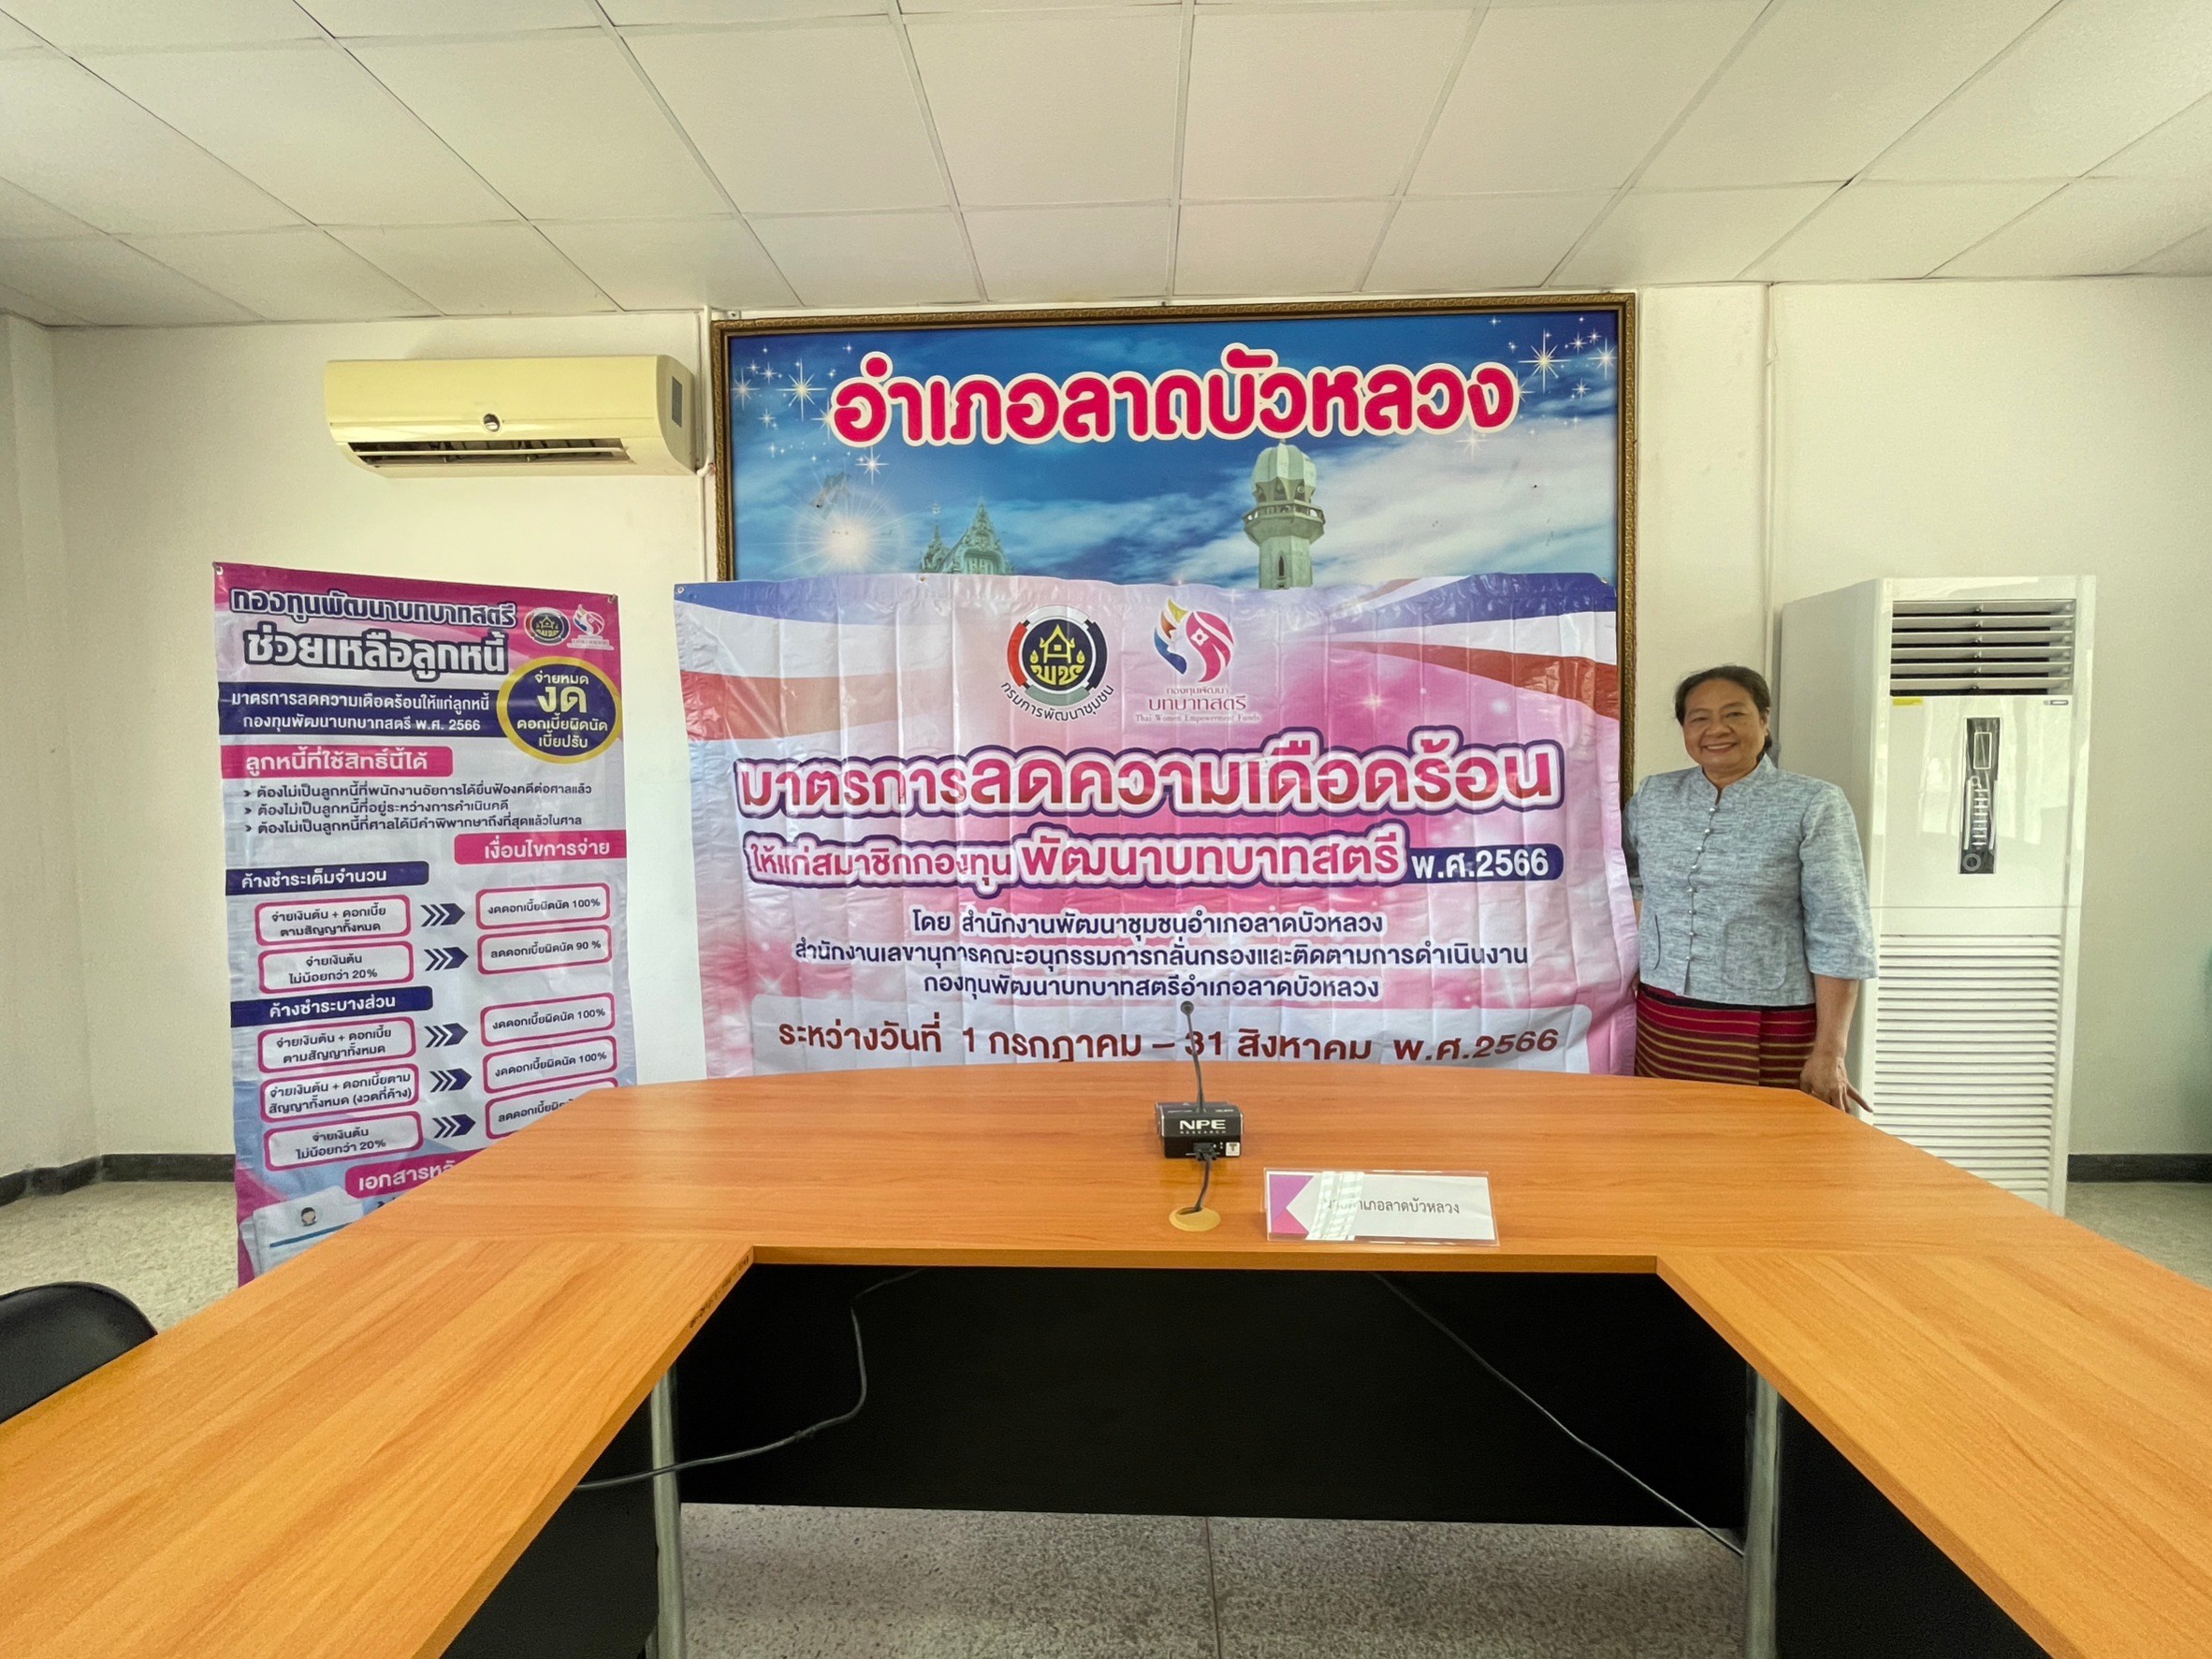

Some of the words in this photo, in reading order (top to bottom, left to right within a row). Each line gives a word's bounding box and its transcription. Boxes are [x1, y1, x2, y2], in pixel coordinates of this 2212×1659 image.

[832, 344, 1518, 444] อำเภอลาดบัวหลวง
[231, 589, 517, 628] กองทุนพัฒนาบทบาทสตรี
[245, 623, 507, 680] ช่วยเหลือลูกหนี้
[535, 670, 589, 684] จ่ายหมด
[232, 692, 489, 715] มาตรการลดความเดือดร้อนให้แก่ลูกหนี้
[537, 686, 588, 713] งด
[1000, 681, 1114, 721] กรมการพัฒนาชุมชน
[1148, 694, 1247, 711] บทบาทสตรี
[243, 714, 411, 732] กองทุนพัฒนาบทบาทสตรี
[416, 718, 444, 730] พ.ศ.
[448, 719, 481, 731] 2566
[517, 713, 608, 731] ดอกเบี้ยผิดนัด
[539, 731, 589, 749] เบี้ยปรับ
[246, 746, 429, 777] ลูกหนี้ที่ใช้สิทธิ์นี้ได้
[739, 736, 1554, 808] มาตรการลดความเดือดร้อน
[484, 836, 610, 861] เงื่อนไขการจ่าย
[750, 839, 1011, 886] ให้แก่สมาชิกกองทุน
[1022, 829, 1400, 877] พัฒนาบทบาทสตรี
[1413, 849, 1550, 880] พ.ศ.2566
[241, 867, 387, 890] ค้างชำระเต็มจำนวน
[271, 909, 328, 923] จ่ายเงินต้น
[342, 902, 386, 918] ดอกเบี้ย
[488, 898, 569, 915] งดดอกเบี้ยผิดนัด
[573, 898, 601, 909] 100%
[280, 919, 381, 937] ตามสัญญาทั้งหมด
[912, 910, 951, 932] โดย
[962, 907, 1384, 941] สำนักงานพัฒนาชุมชนอำเภอลาดบัวหลวง
[306, 953, 362, 967] จ่ายเงินต้น
[490, 941, 574, 958] ลดดอกเบี้ยผิดนัด
[576, 941, 589, 950] 90
[795, 937, 1528, 970] สำนักงานเลขานุการคณะอนุกรรมการกลั่นกรองและติดตามการดำเนินงาน
[289, 969, 349, 984] ไม่น้อยกว่า
[352, 968, 377, 979] 20%
[924, 973, 1379, 999] กองทุนพัฒนาบทบาทสตรีอำเภอลาดบัวหลวง
[269, 993, 396, 1019] ค้างชำระบางส่วน
[492, 1011, 575, 1029] งดดอกเบี้ยผิดนัด
[577, 1008, 605, 1019] 100%
[276, 1032, 335, 1048] จ่ายเงินต้น
[349, 1025, 391, 1041] ดอกเบี้ย
[779, 1011, 942, 1053] ระหว่างวันที่
[963, 1026, 975, 1053] 1
[988, 1030, 1142, 1063] กรกฎาคม
[1185, 1030, 1221, 1055] 31
[1237, 1027, 1372, 1060] สิงหาคม
[1393, 1028, 1559, 1061] พ.ศ.2566
[284, 1042, 386, 1063] ตามสัญญาทั้งหมด
[495, 1056, 576, 1077] งดดอกเบี้ยผิดนัด
[579, 1052, 607, 1063] 100%
[269, 1082, 328, 1098] จ่ายเงินต้น
[342, 1072, 411, 1089] ดอกเบี้ยตาม
[269, 1095, 349, 1114] สัญญาทั้งหมด
[354, 1086, 412, 1105] (งวดที่ค้าง)
[313, 1127, 369, 1142] จ่ายเงินต้น
[1179, 1119, 1226, 1130] NPE
[296, 1142, 357, 1159] ไม่น้อยกว่า
[359, 1140, 386, 1151] 20%
